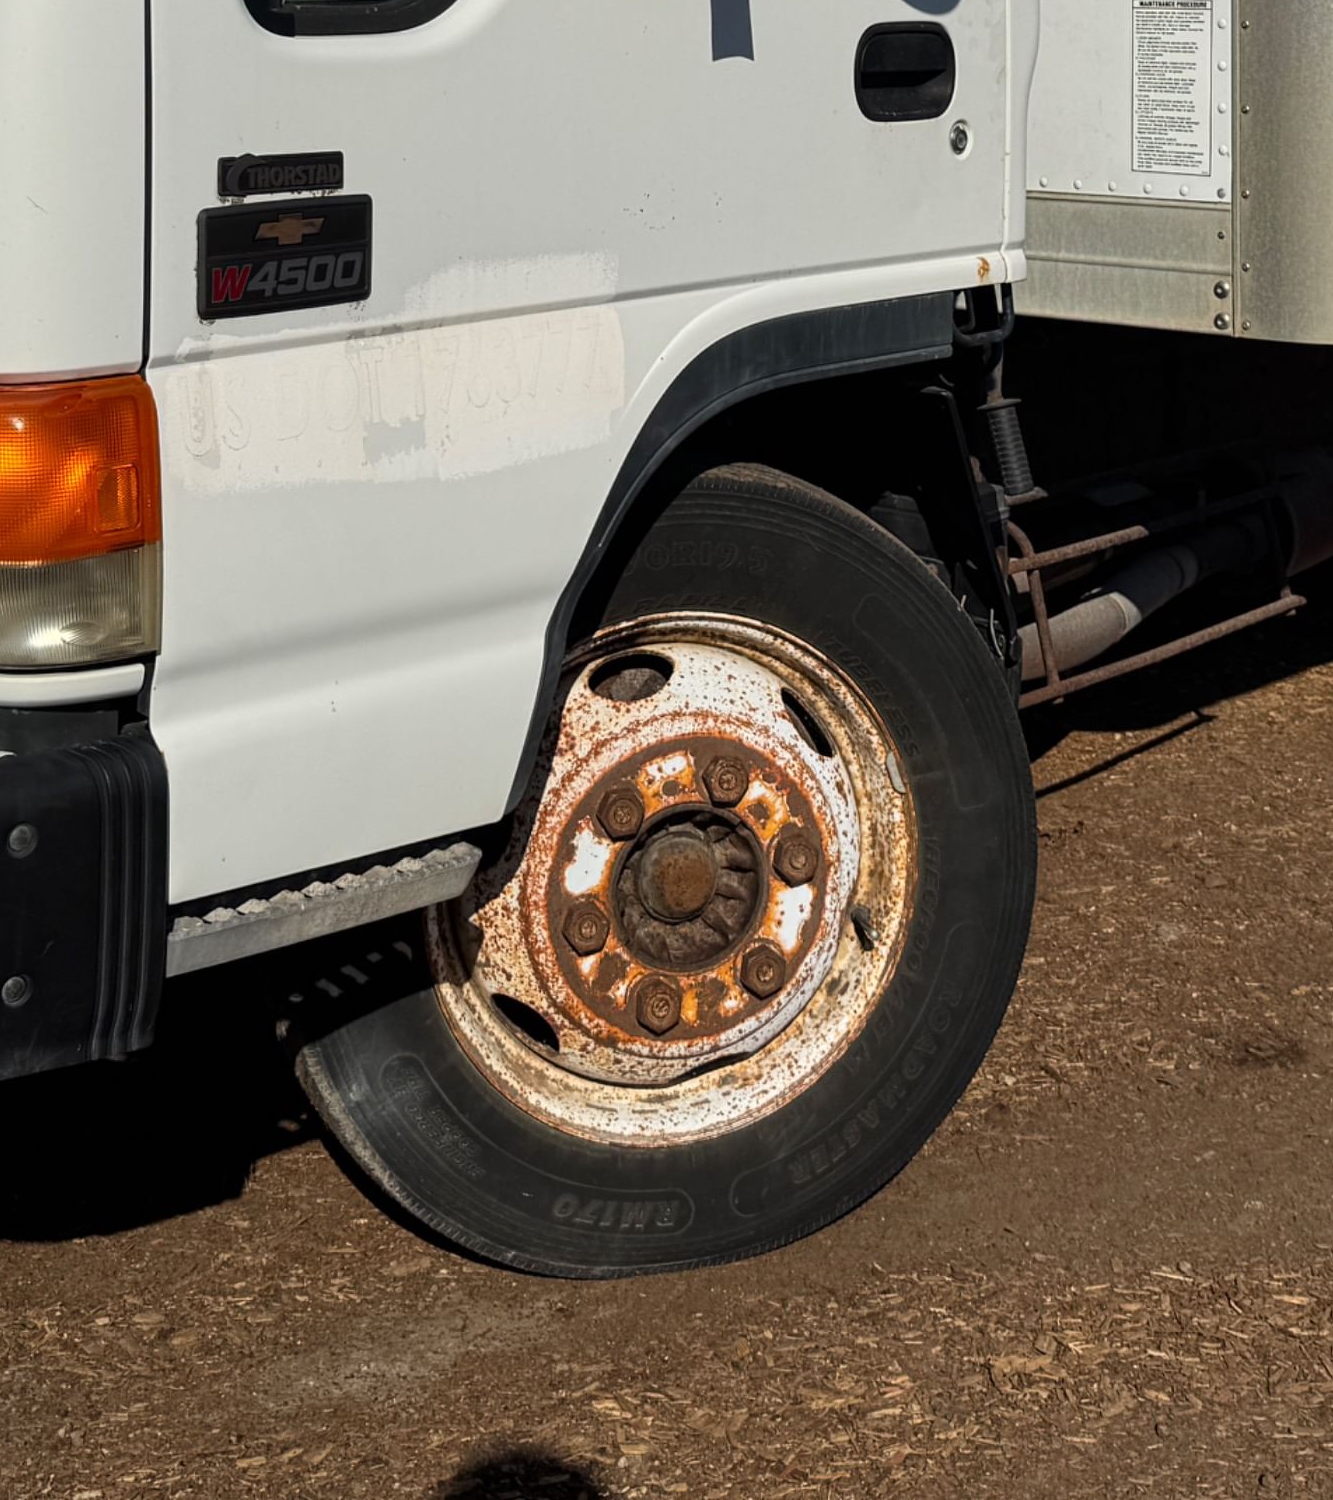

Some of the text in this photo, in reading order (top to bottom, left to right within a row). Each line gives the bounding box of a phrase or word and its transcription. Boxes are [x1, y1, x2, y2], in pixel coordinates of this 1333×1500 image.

[246, 163, 340, 189] THORSTAD
[211, 251, 364, 304] W4500
[552, 1193, 680, 1231] RM170
